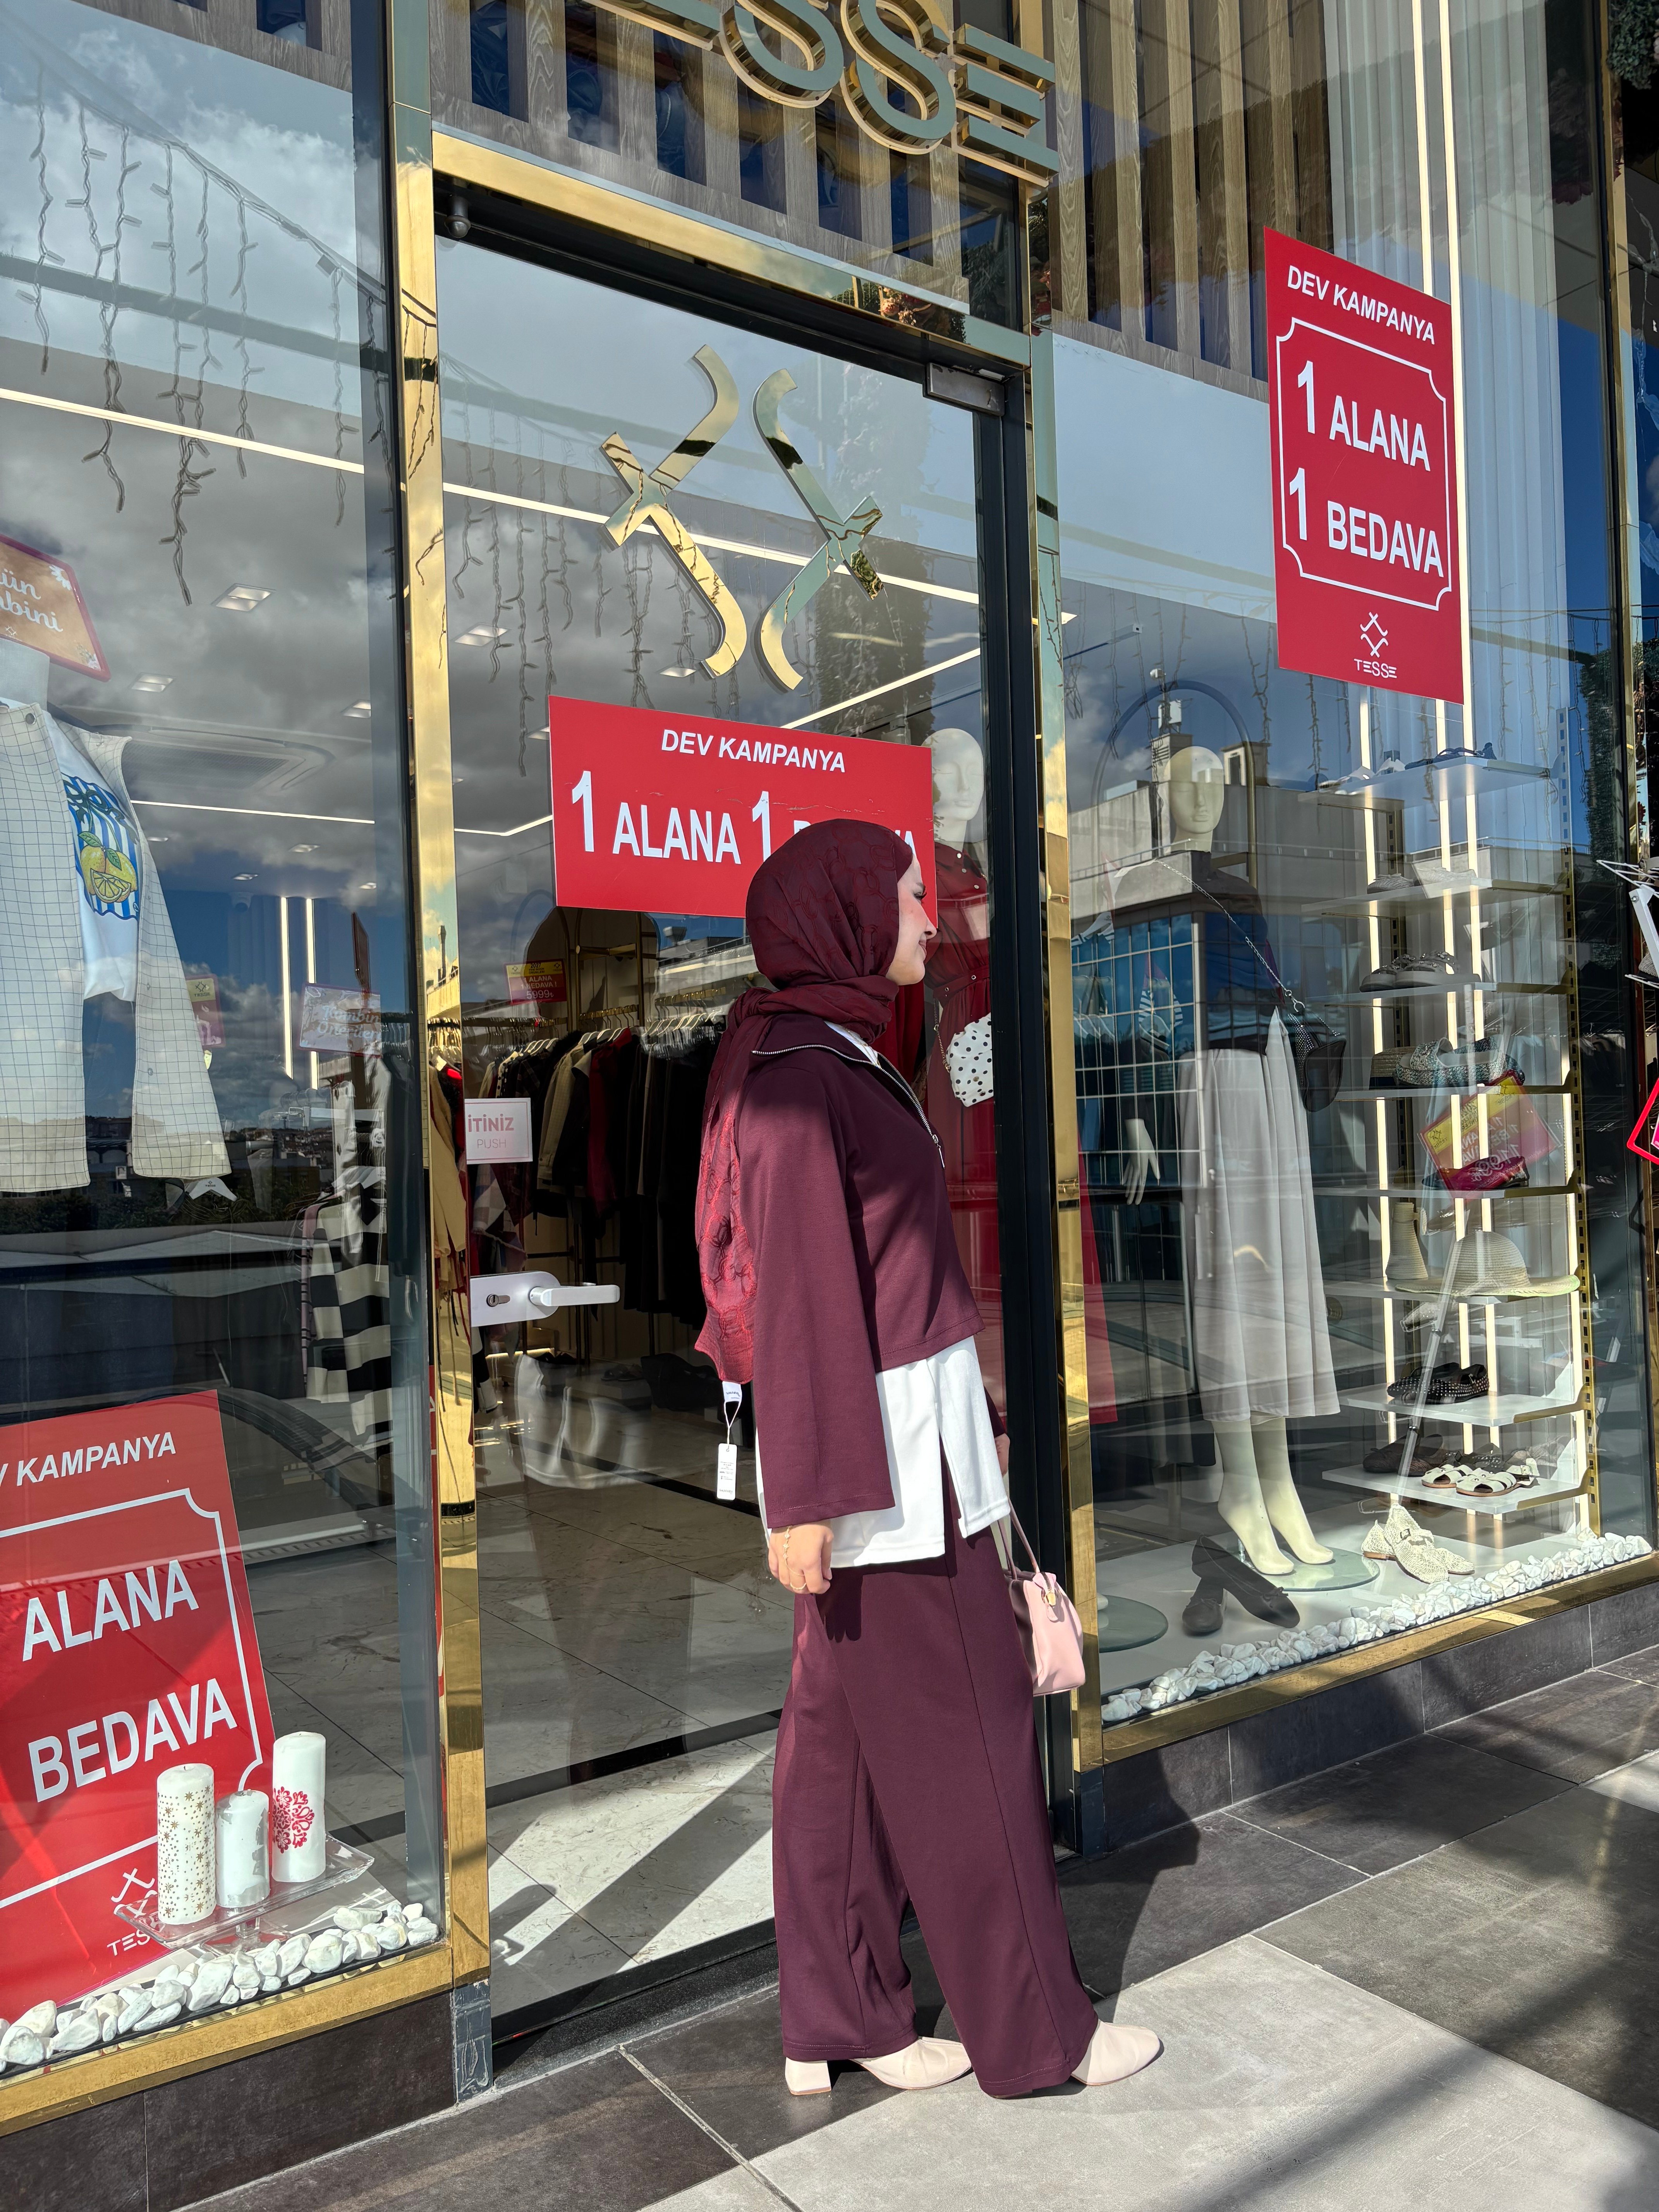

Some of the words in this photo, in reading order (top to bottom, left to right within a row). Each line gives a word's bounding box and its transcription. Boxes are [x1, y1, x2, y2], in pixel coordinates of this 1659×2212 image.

[592, 0, 1059, 187] SSE
[1287, 265, 1330, 300] DEV
[1333, 284, 1435, 345] KAMPANYA
[1298, 360, 1316, 434] 1
[1329, 395, 1431, 472] ALANA
[1289, 467, 1307, 541] 1
[1327, 500, 1444, 578] BEDAVA
[0, 568, 41, 599] ün
[1353, 658, 1398, 678] TESSE
[661, 729, 714, 756] DEV
[718, 737, 845, 773] KAMPANYA
[572, 770, 594, 852] 1
[612, 802, 742, 864] ALANA
[752, 791, 771, 862] 1
[468, 1113, 514, 1132] İTİNİZ
[477, 1139, 507, 1149] PUSH
[17, 1432, 176, 1486] KAMPANYA
[22, 1559, 199, 1662] ALANA
[28, 1678, 238, 1803] BEDAVA
[106, 1929, 151, 1956] TES
